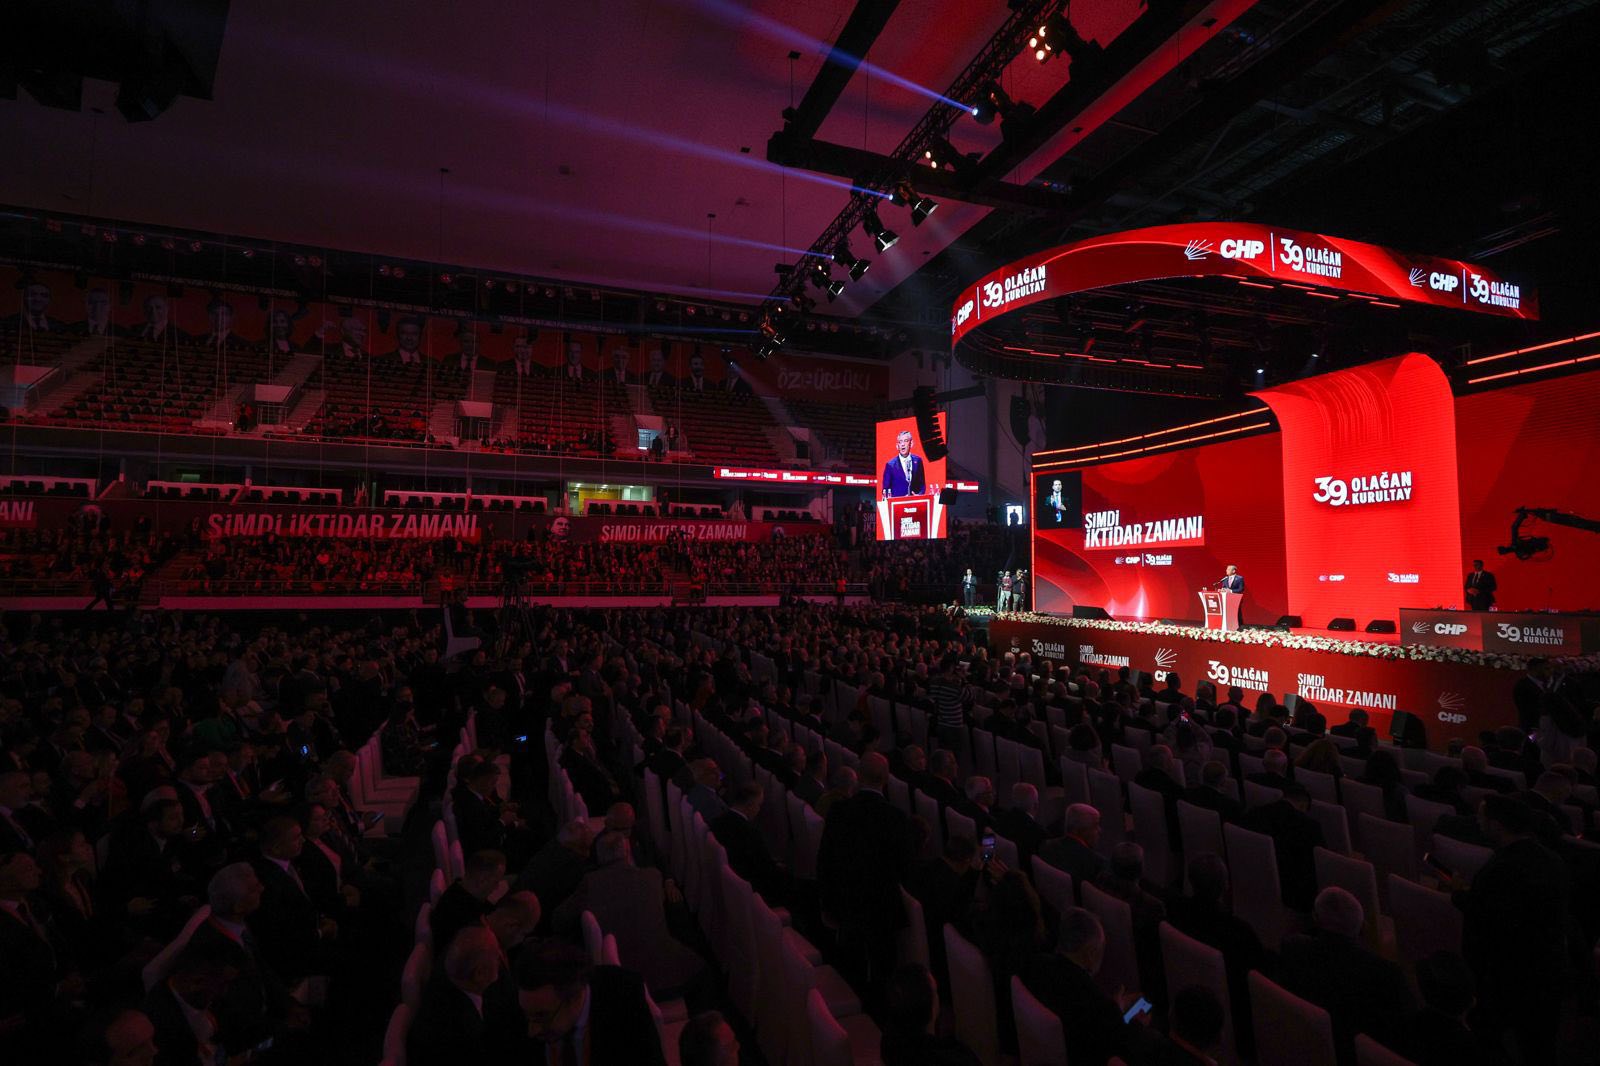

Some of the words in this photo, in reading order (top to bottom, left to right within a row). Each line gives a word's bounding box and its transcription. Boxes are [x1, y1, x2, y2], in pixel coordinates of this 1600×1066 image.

[1220, 239, 1264, 259] CHP
[1280, 237, 1305, 272] 39.
[1306, 247, 1342, 267] OLAĞAN
[1306, 261, 1342, 279] KURULTAY
[983, 281, 1004, 307] 39.
[1004, 265, 1046, 291] OLAĞAN
[1005, 280, 1046, 303] KURULTAY
[1429, 272, 1459, 292] CHP
[1470, 273, 1491, 304] 39.
[1491, 281, 1520, 299] OLAĞAN
[1491, 295, 1520, 309] KURULTAY
[957, 300, 974, 326] CHP
[1313, 476, 1350, 507] 39.
[1351, 471, 1412, 493] OLAĞAN
[1352, 487, 1412, 505] KURULTAY
[389, 513, 477, 538] ZAMANI
[698, 524, 747, 540] ZAMANI
[1144, 515, 1203, 543] ZAMANI
[1434, 623, 1467, 635] CHP
[1497, 623, 1522, 642] 39.
[1523, 626, 1563, 638] OLAĞAN
[1031, 638, 1044, 657] 39.
[1523, 636, 1563, 645] KURULTAY
[1103, 655, 1129, 667] ZAMANI
[1207, 660, 1231, 686] 39.
[1231, 667, 1269, 682] OLAĞAN
[1231, 678, 1268, 692] KURULTAY
[1346, 690, 1397, 710] ZAMANI
[1438, 711, 1467, 723] CHP
